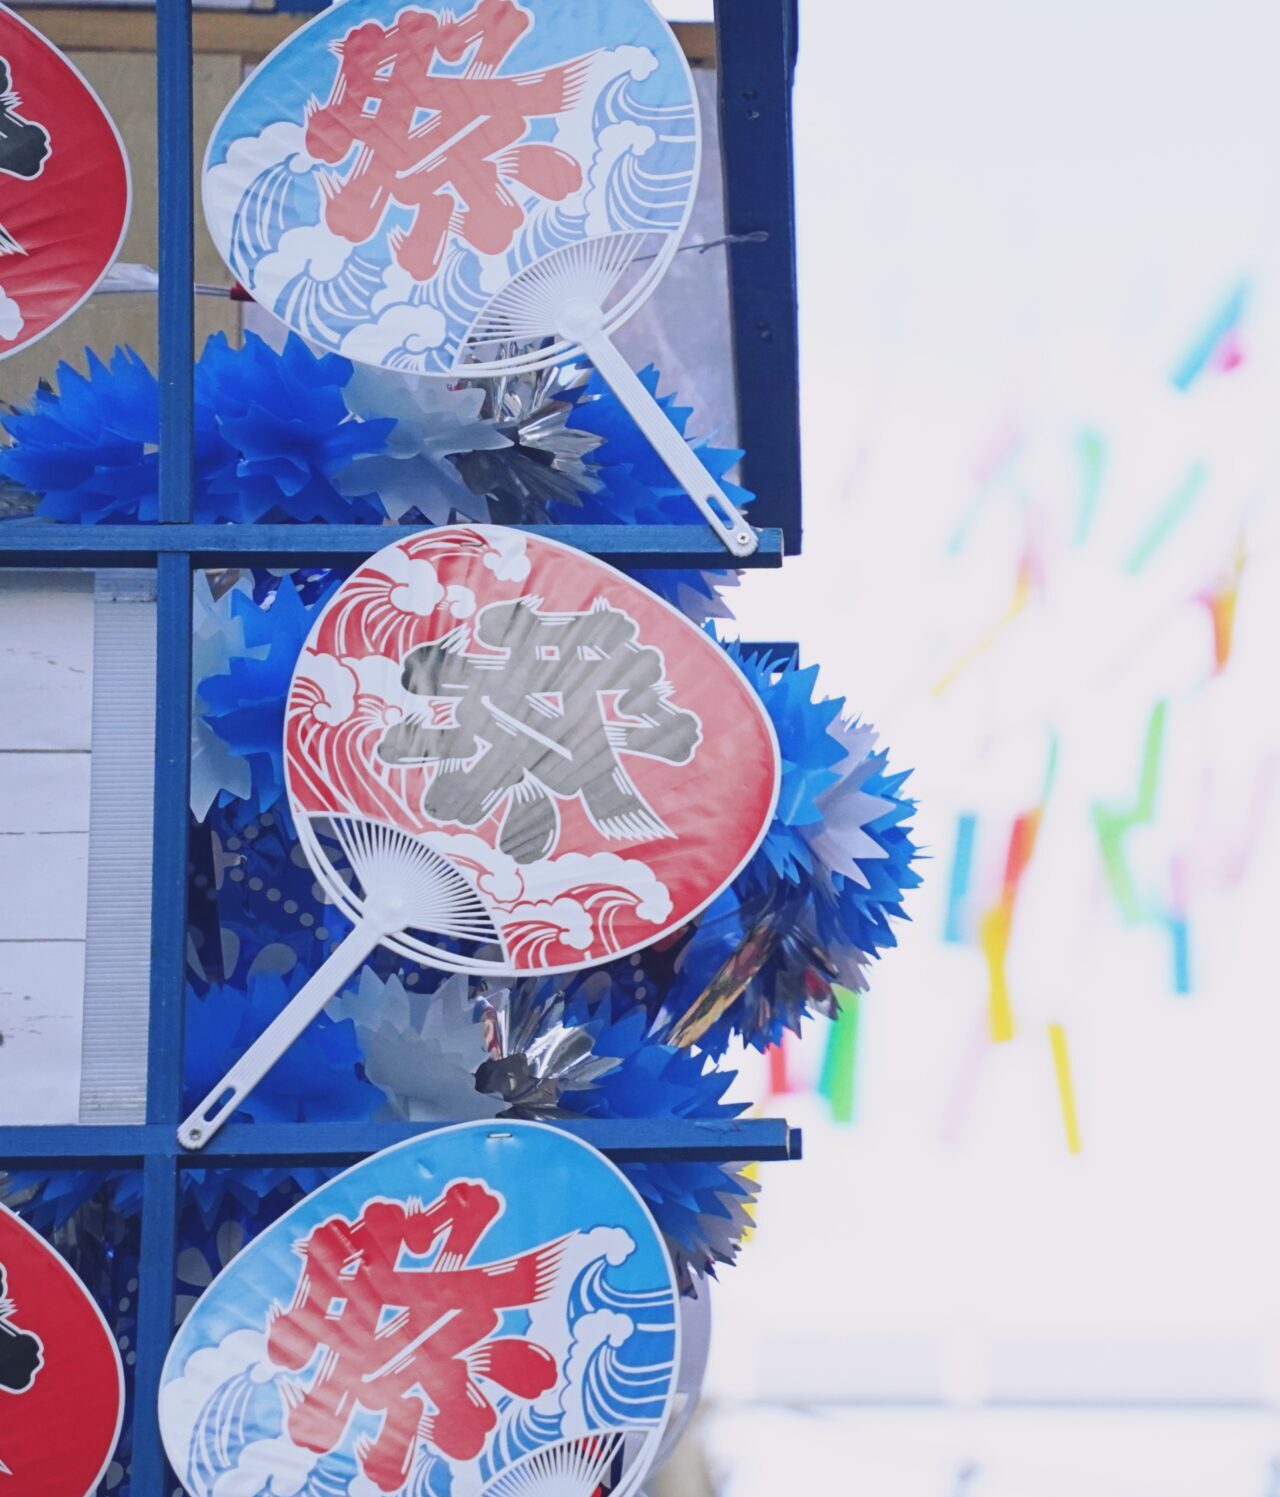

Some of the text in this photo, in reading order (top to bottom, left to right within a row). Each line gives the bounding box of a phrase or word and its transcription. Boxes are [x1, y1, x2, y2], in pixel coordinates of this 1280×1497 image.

[304, 0, 605, 281] 祭
[378, 594, 702, 864] 祭
[266, 1178, 581, 1494] 祭
